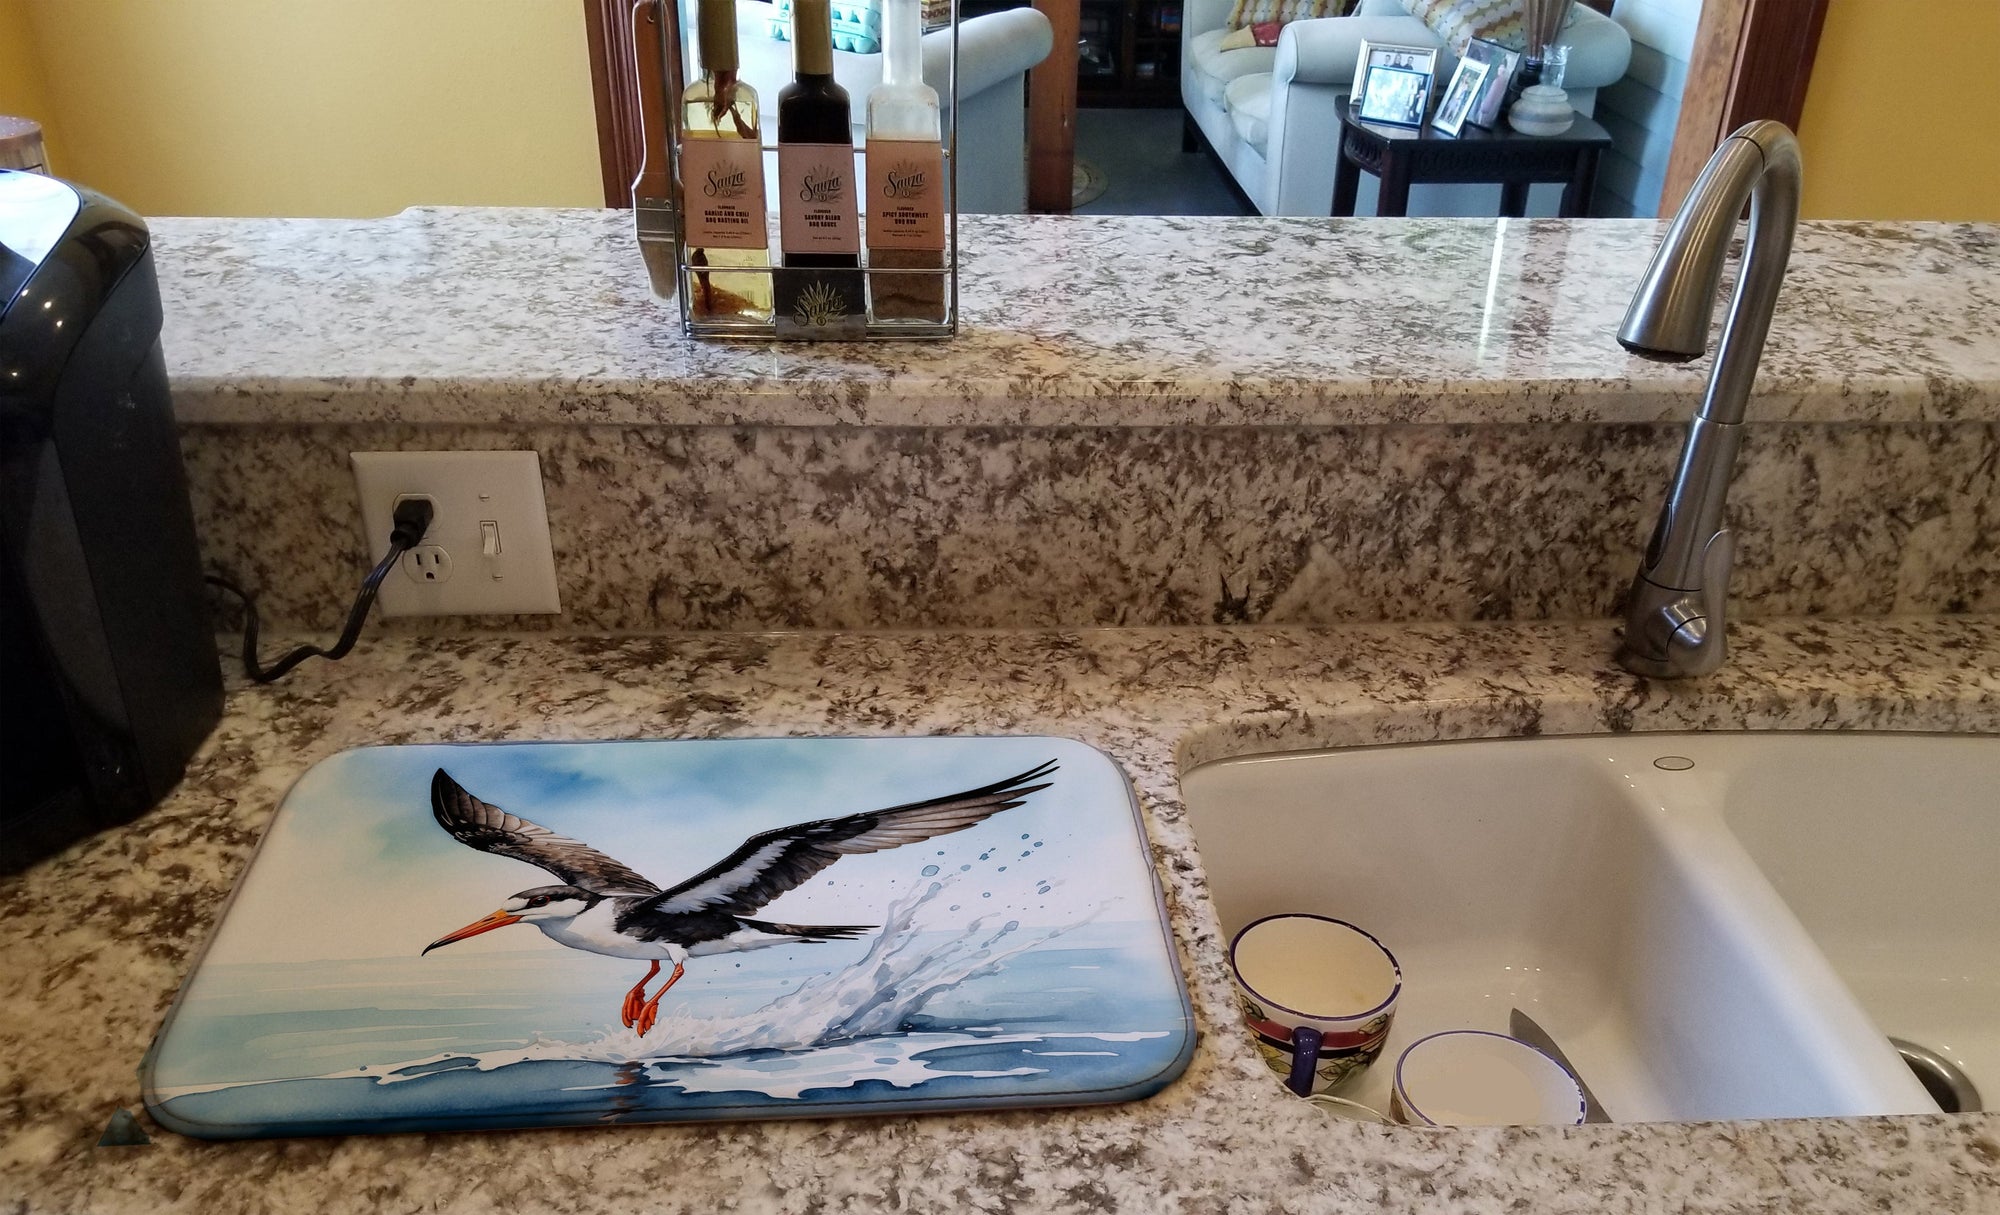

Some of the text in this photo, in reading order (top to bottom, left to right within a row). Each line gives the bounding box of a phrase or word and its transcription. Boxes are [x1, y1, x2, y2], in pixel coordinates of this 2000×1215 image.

[703, 170, 745, 197] Sauza
[800, 175, 841, 202] Sauza
[884, 171, 924, 198] Sauza
[793, 295, 845, 327] Sauza
